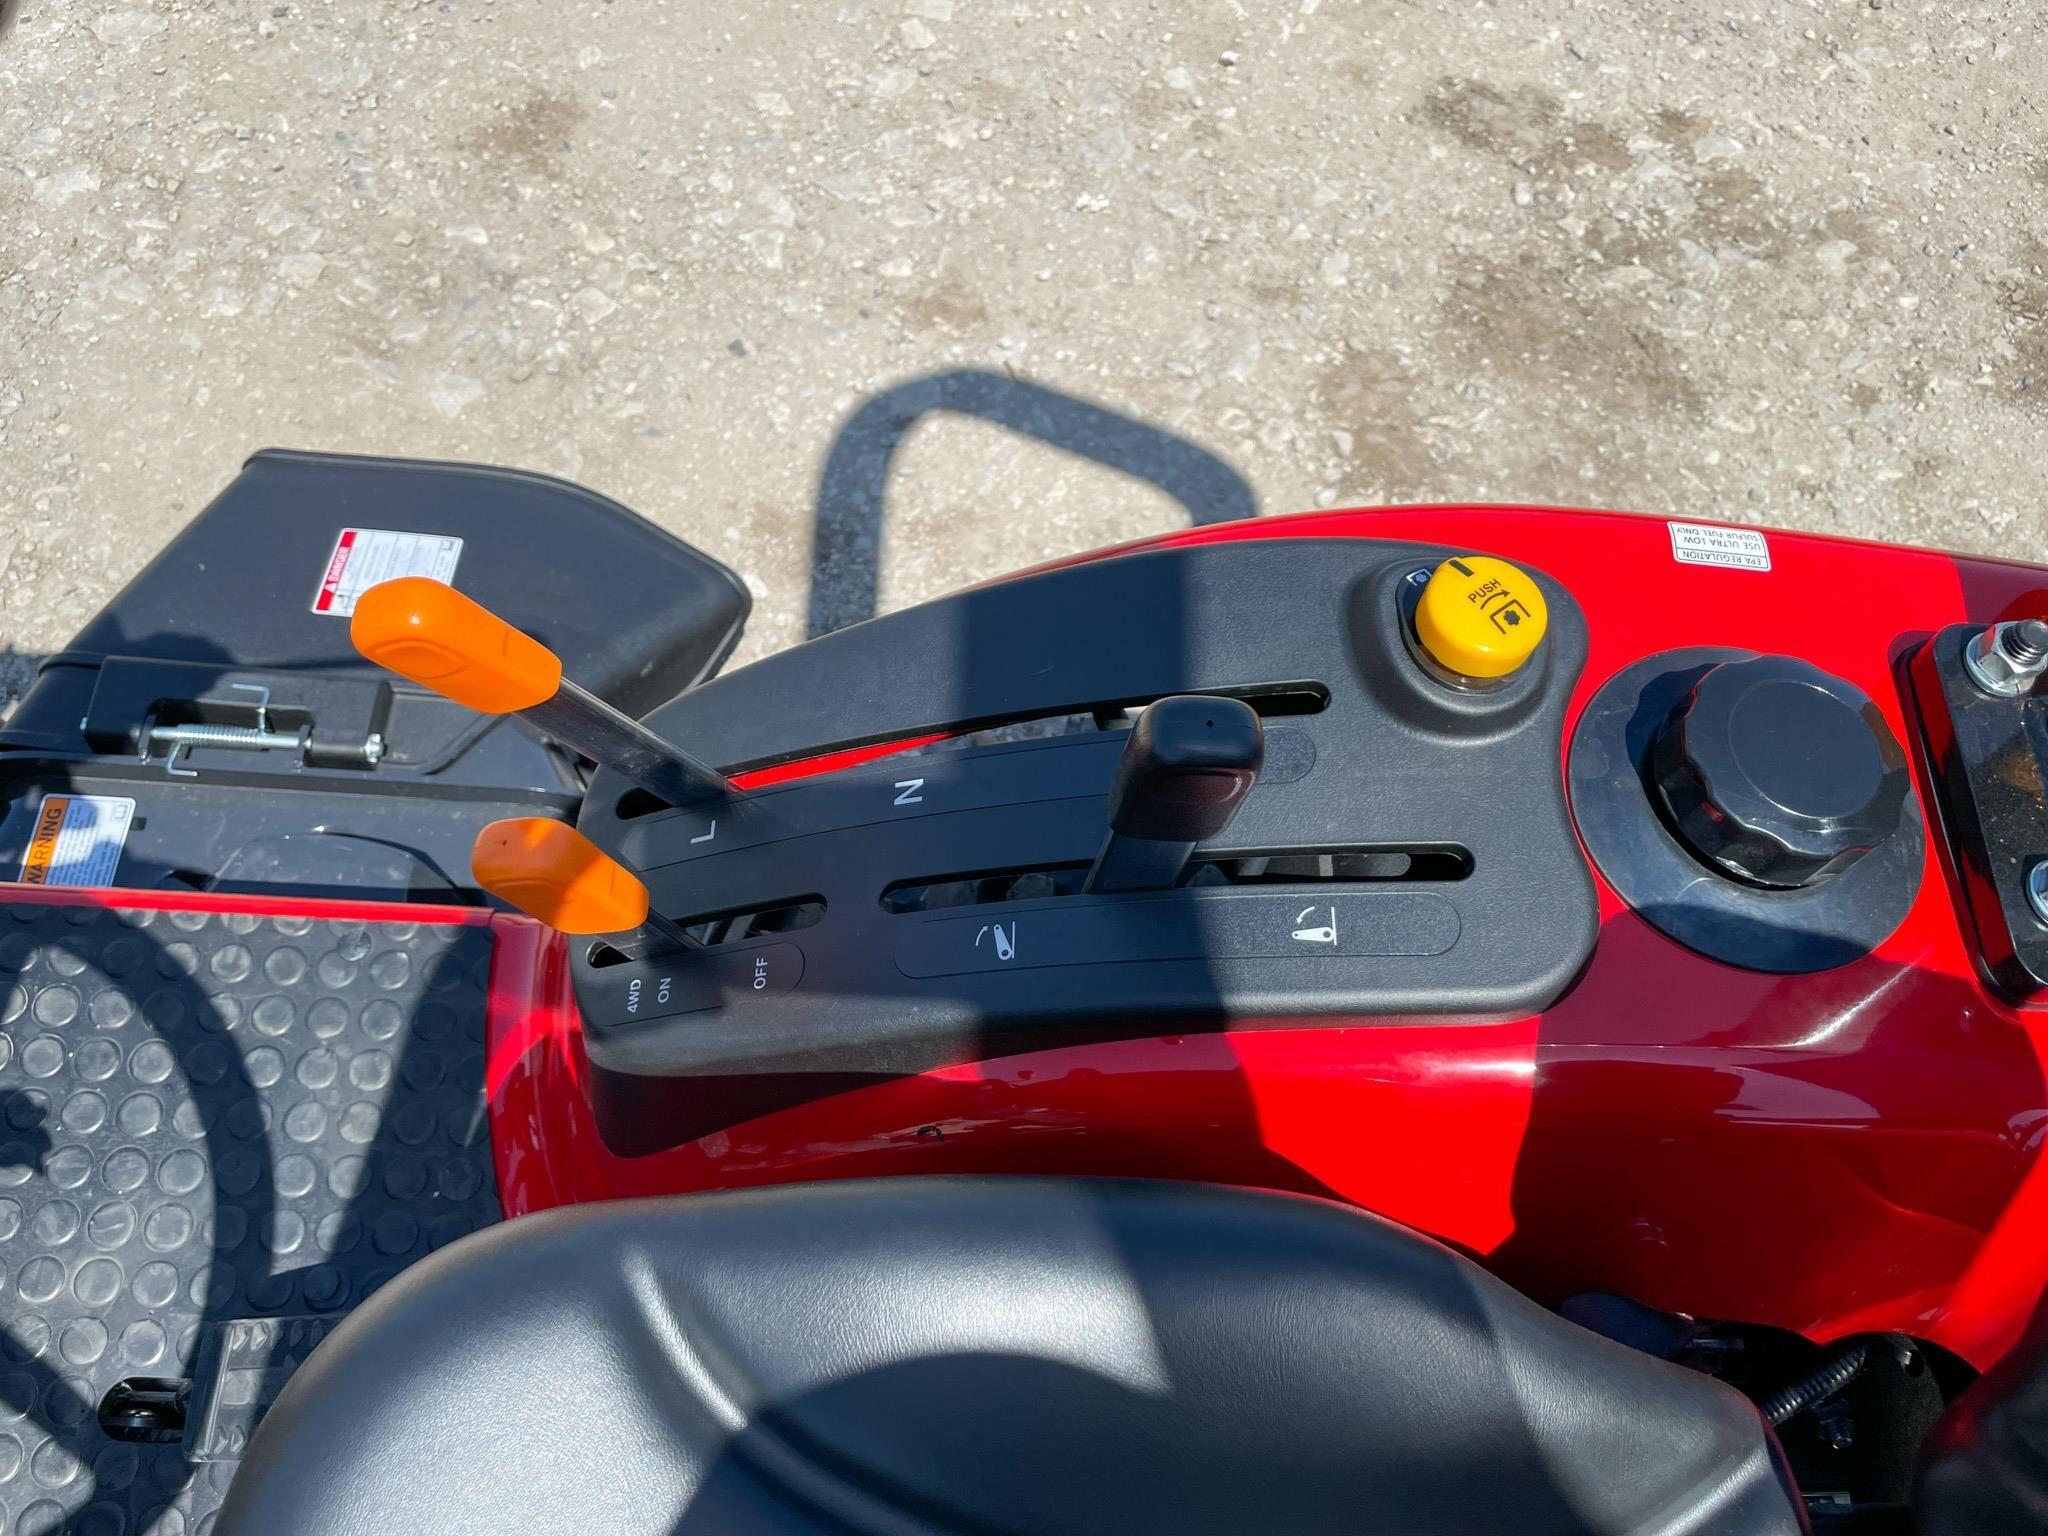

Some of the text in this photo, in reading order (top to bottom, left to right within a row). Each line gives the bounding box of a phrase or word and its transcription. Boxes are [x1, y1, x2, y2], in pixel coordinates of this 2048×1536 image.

[1676, 527, 1759, 542] SULFUR FUEL ONLY
[1683, 536, 1761, 551] USE ULTRA LOW
[1682, 550, 1762, 566] EPA REGULATION
[1467, 578, 1502, 603] PUSH
[893, 778, 924, 806] N
[690, 820, 716, 844] L
[753, 957, 768, 990] OFF
[626, 979, 642, 1014] 4WD
[657, 977, 672, 1004] ON
